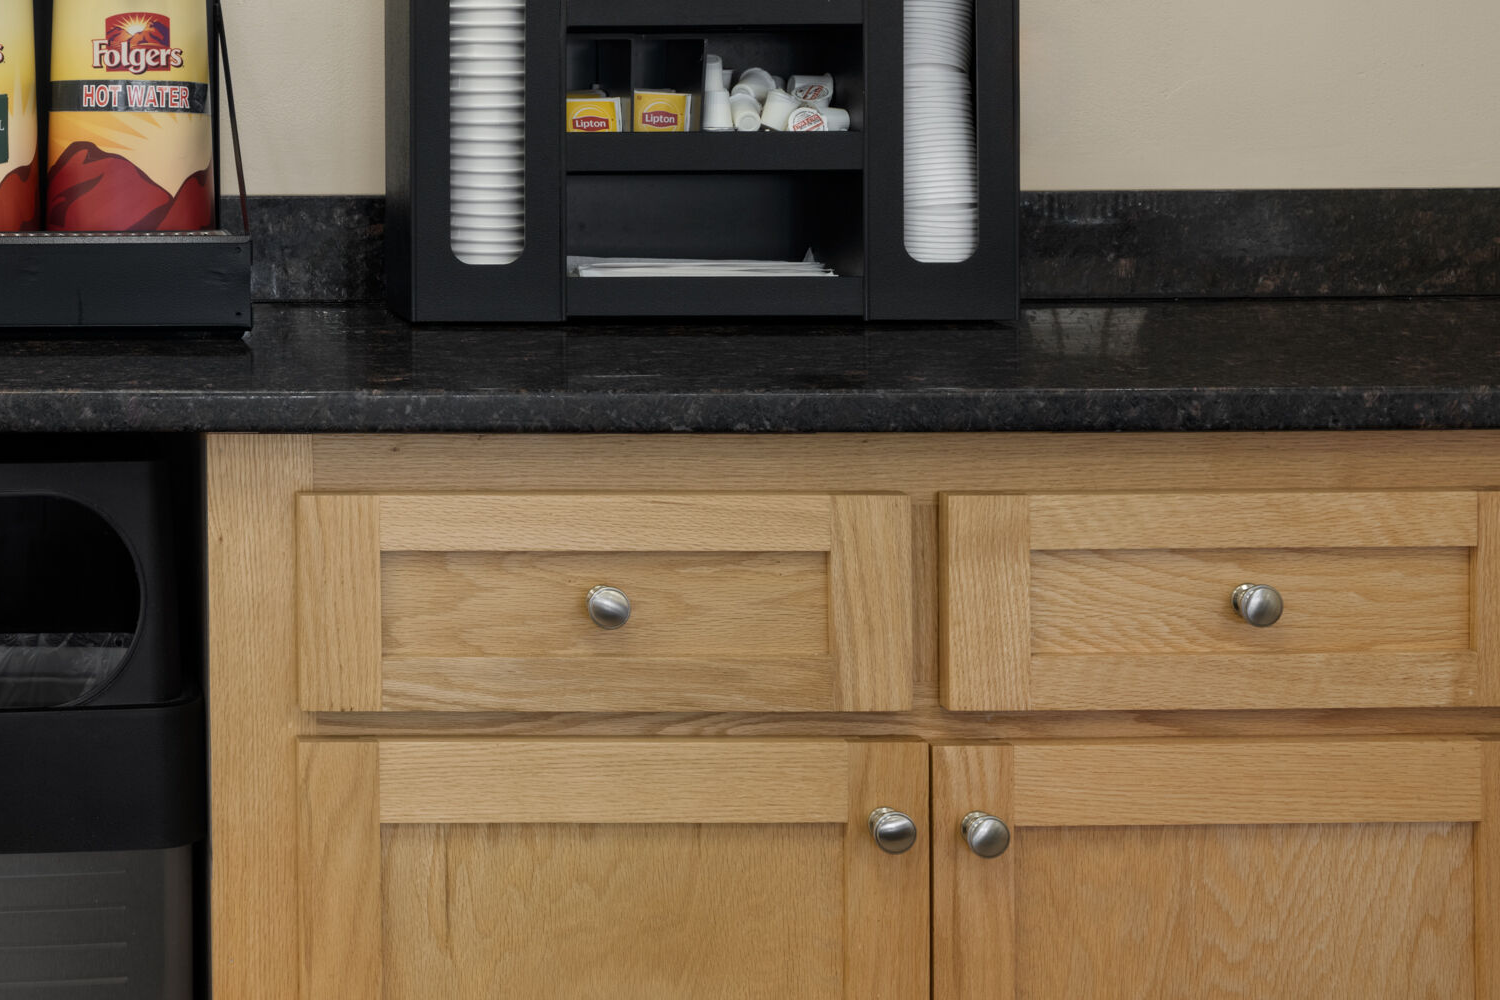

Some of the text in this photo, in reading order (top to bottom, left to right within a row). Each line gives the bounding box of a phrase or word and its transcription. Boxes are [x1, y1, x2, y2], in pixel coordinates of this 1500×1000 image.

[92, 39, 184, 75] Folgers
[82, 84, 190, 109] HOT WATER
[575, 119, 607, 129] Lipton
[645, 113, 676, 124] Lipton
